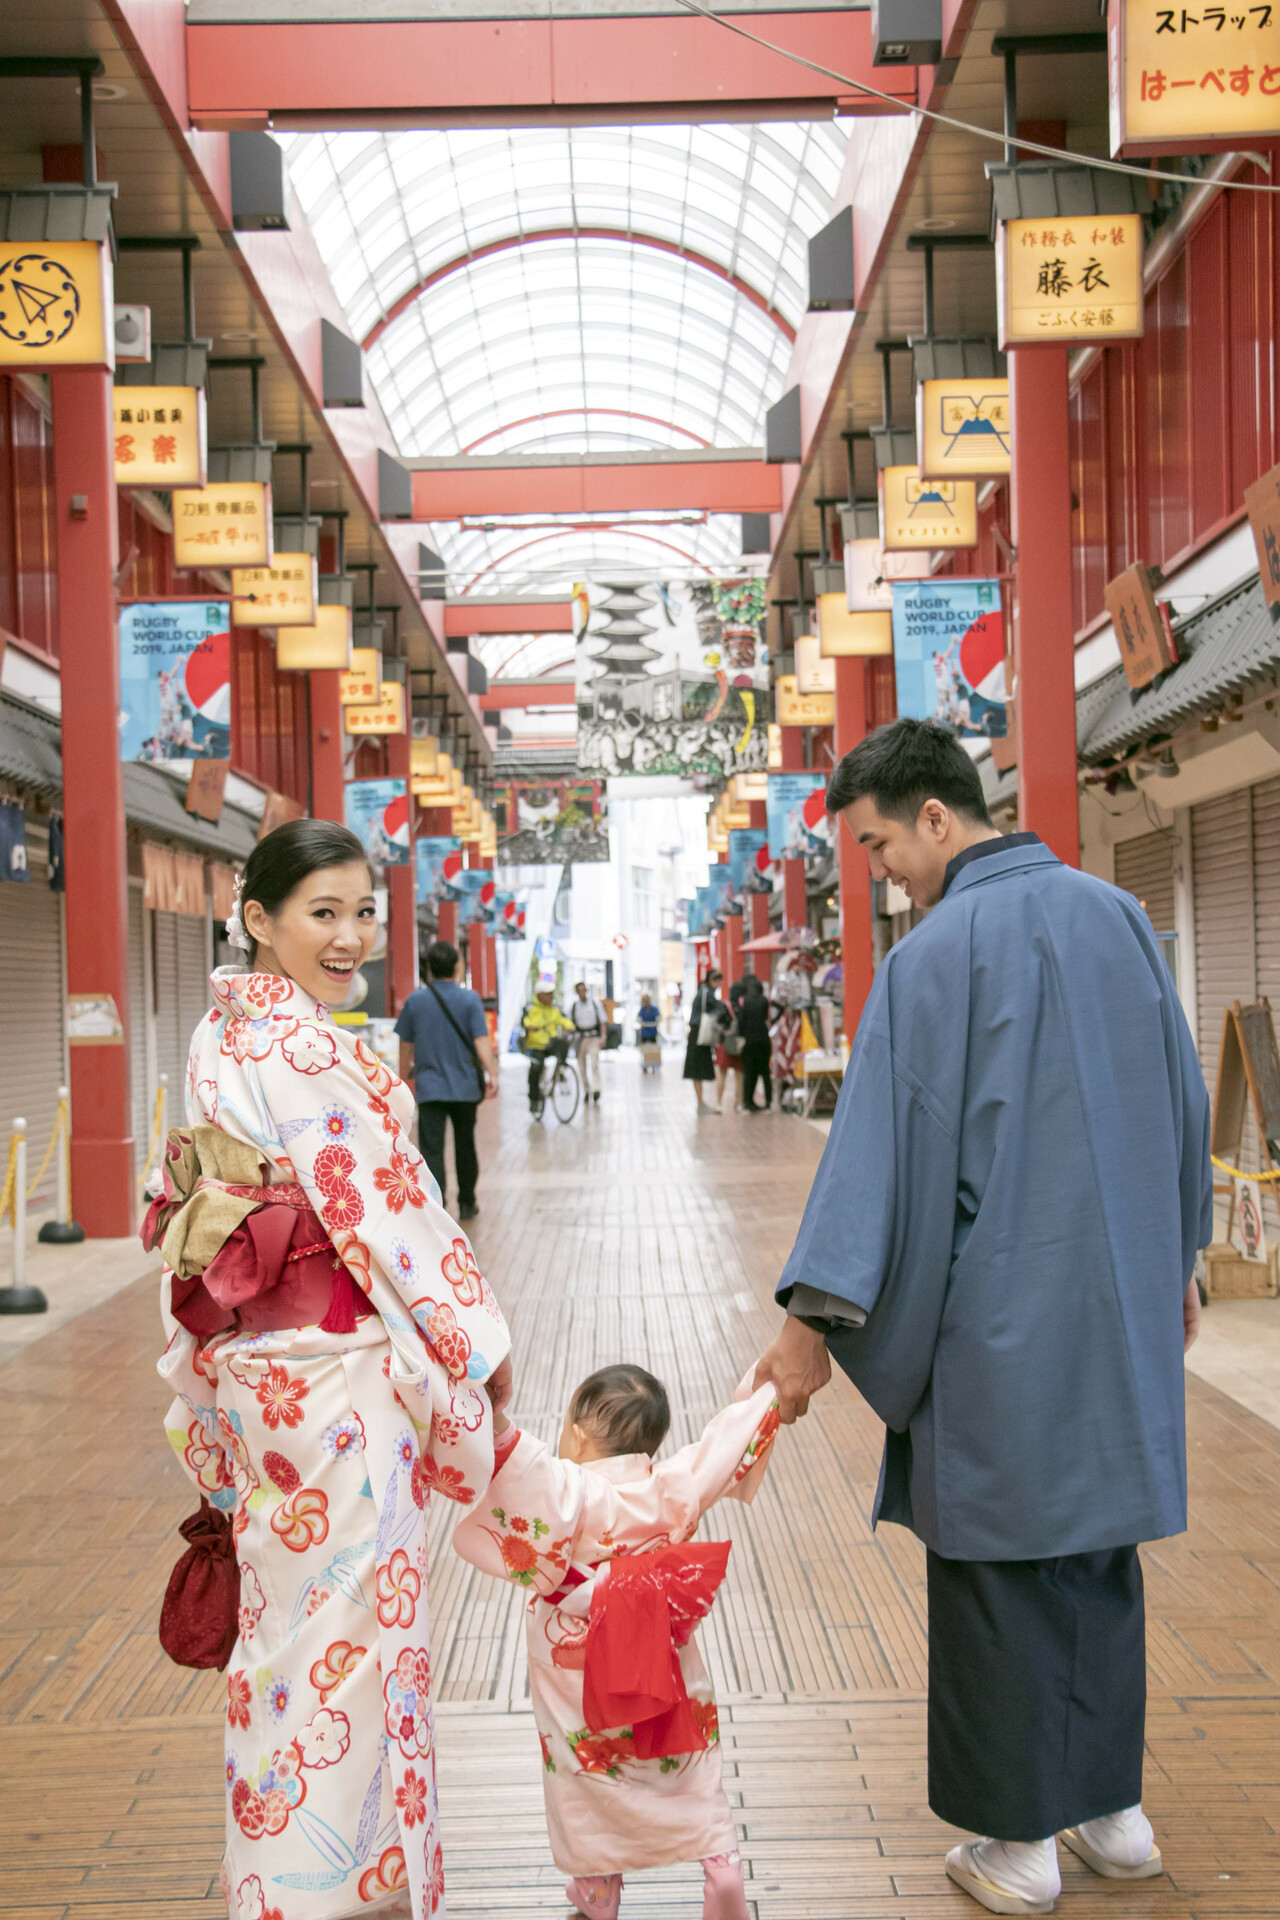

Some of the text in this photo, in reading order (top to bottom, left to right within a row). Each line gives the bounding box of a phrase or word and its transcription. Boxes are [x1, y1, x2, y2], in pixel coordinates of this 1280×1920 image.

[1155, 4, 1273, 34] ストラップ
[1140, 64, 1280, 102] はーべすと
[1021, 226, 1127, 248] 作務衣 和装
[1036, 257, 1110, 298] 藤衣
[1037, 308, 1116, 327] ごふく安藤
[897, 527, 962, 538] FUJIYA
[904, 598, 952, 610] RUGBY
[132, 617, 180, 629] RUGBY
[905, 609, 986, 623] WORLD CUP
[132, 630, 214, 642] WORLD CUP
[905, 623, 987, 637] 2019, JAPAN
[132, 643, 214, 656] 2019, JAPAN
